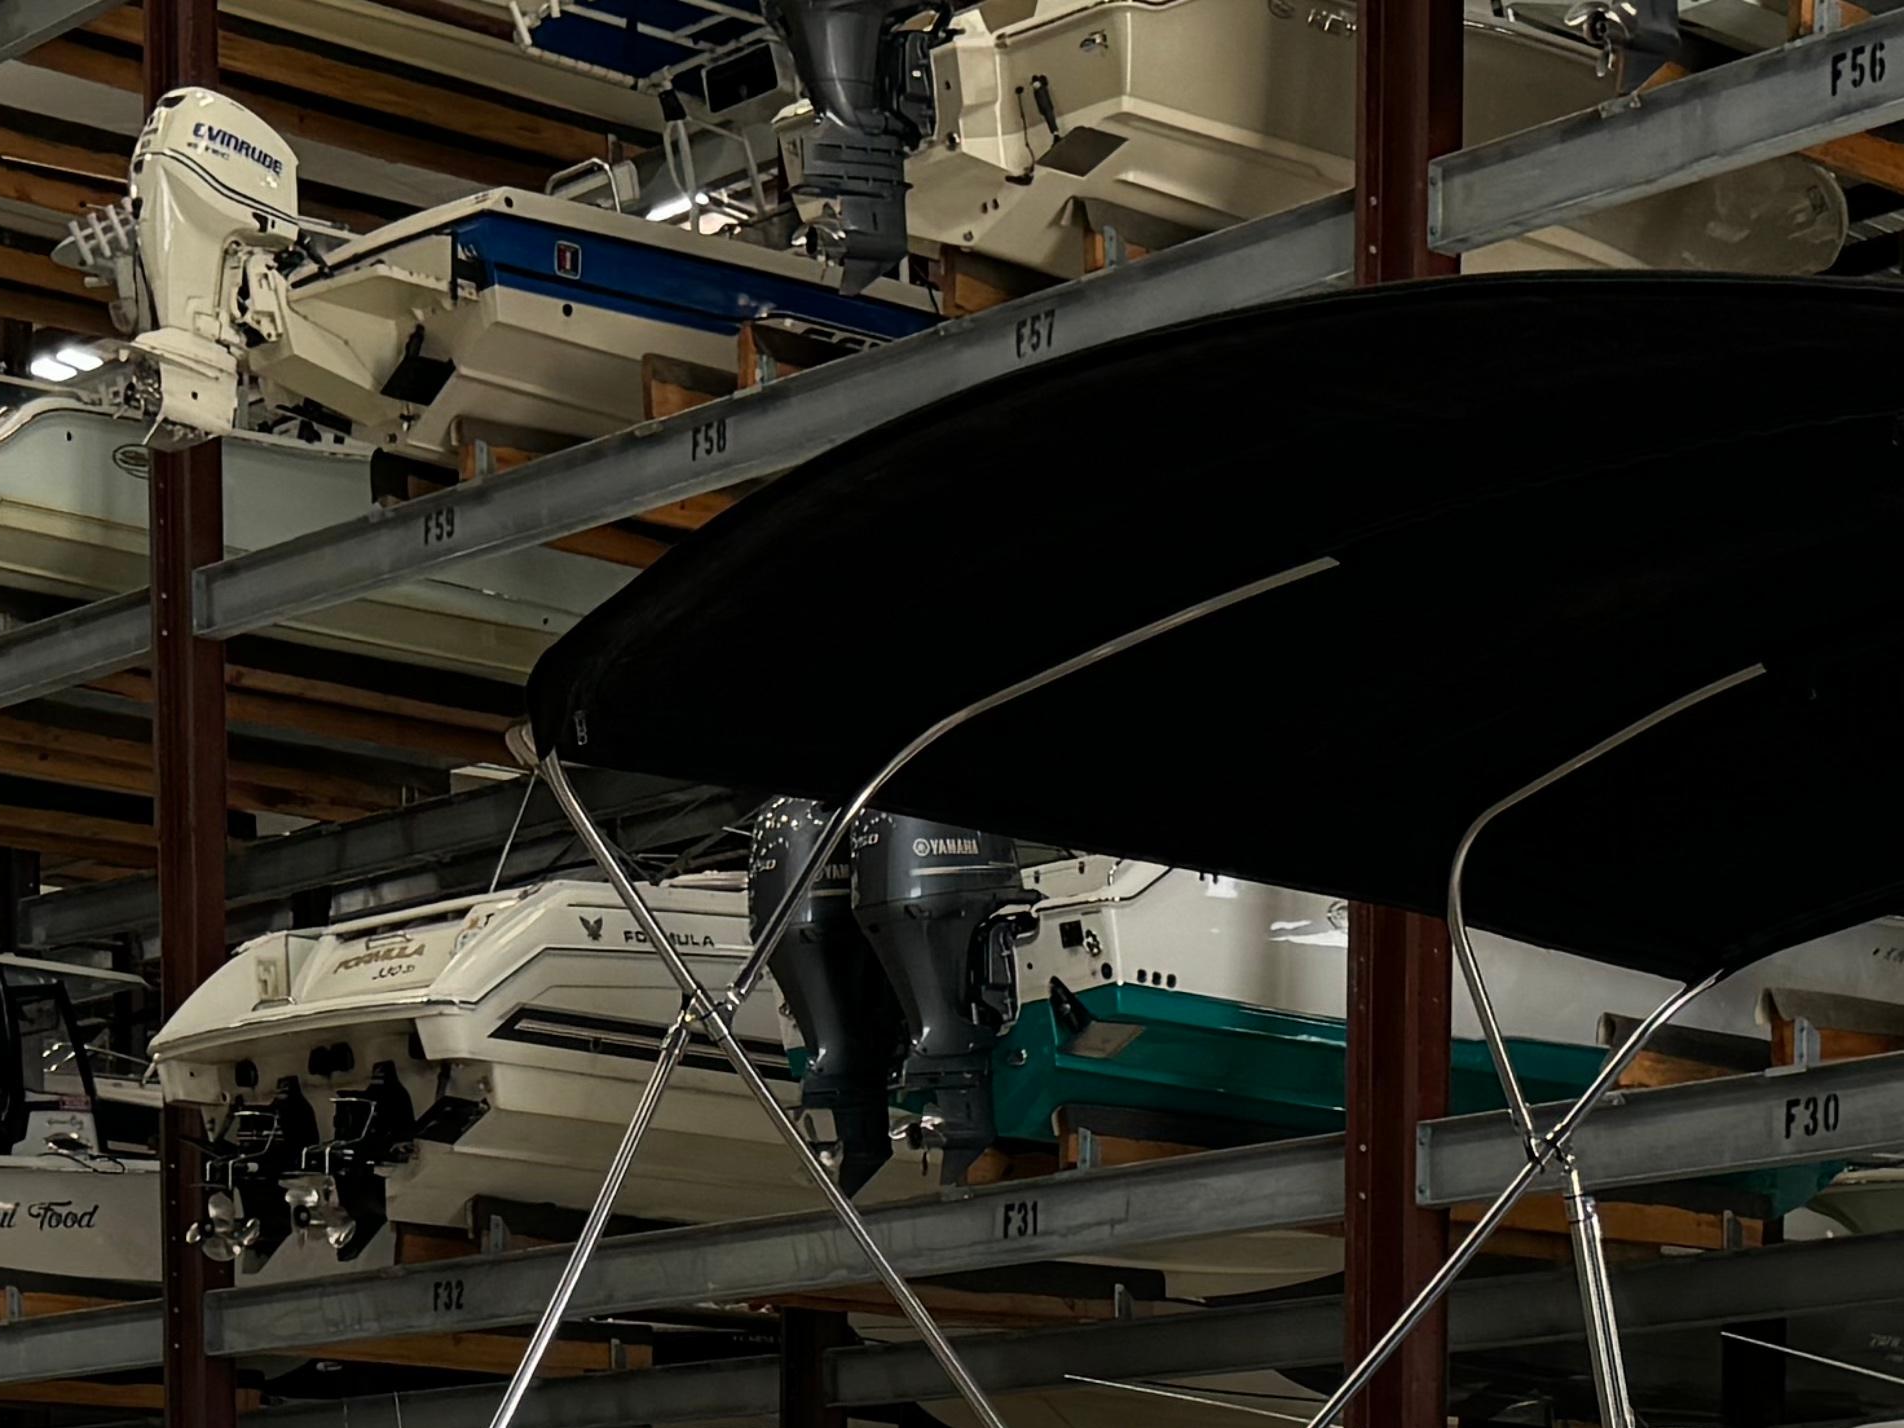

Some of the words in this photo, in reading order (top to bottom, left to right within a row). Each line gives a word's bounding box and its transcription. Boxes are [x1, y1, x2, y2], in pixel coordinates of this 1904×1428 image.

[1831, 42, 1885, 96] F56
[192, 122, 284, 175] EVINRUDE
[1016, 309, 1055, 359] F57
[692, 419, 727, 461] F58
[424, 507, 454, 546] F59
[930, 838, 979, 855] YAMAHA
[623, 930, 715, 947] FOMULA
[1785, 1094, 1840, 1139] F30
[27, 1200, 100, 1231] Food
[1003, 1202, 1040, 1239] F31
[433, 1280, 464, 1311] F32
